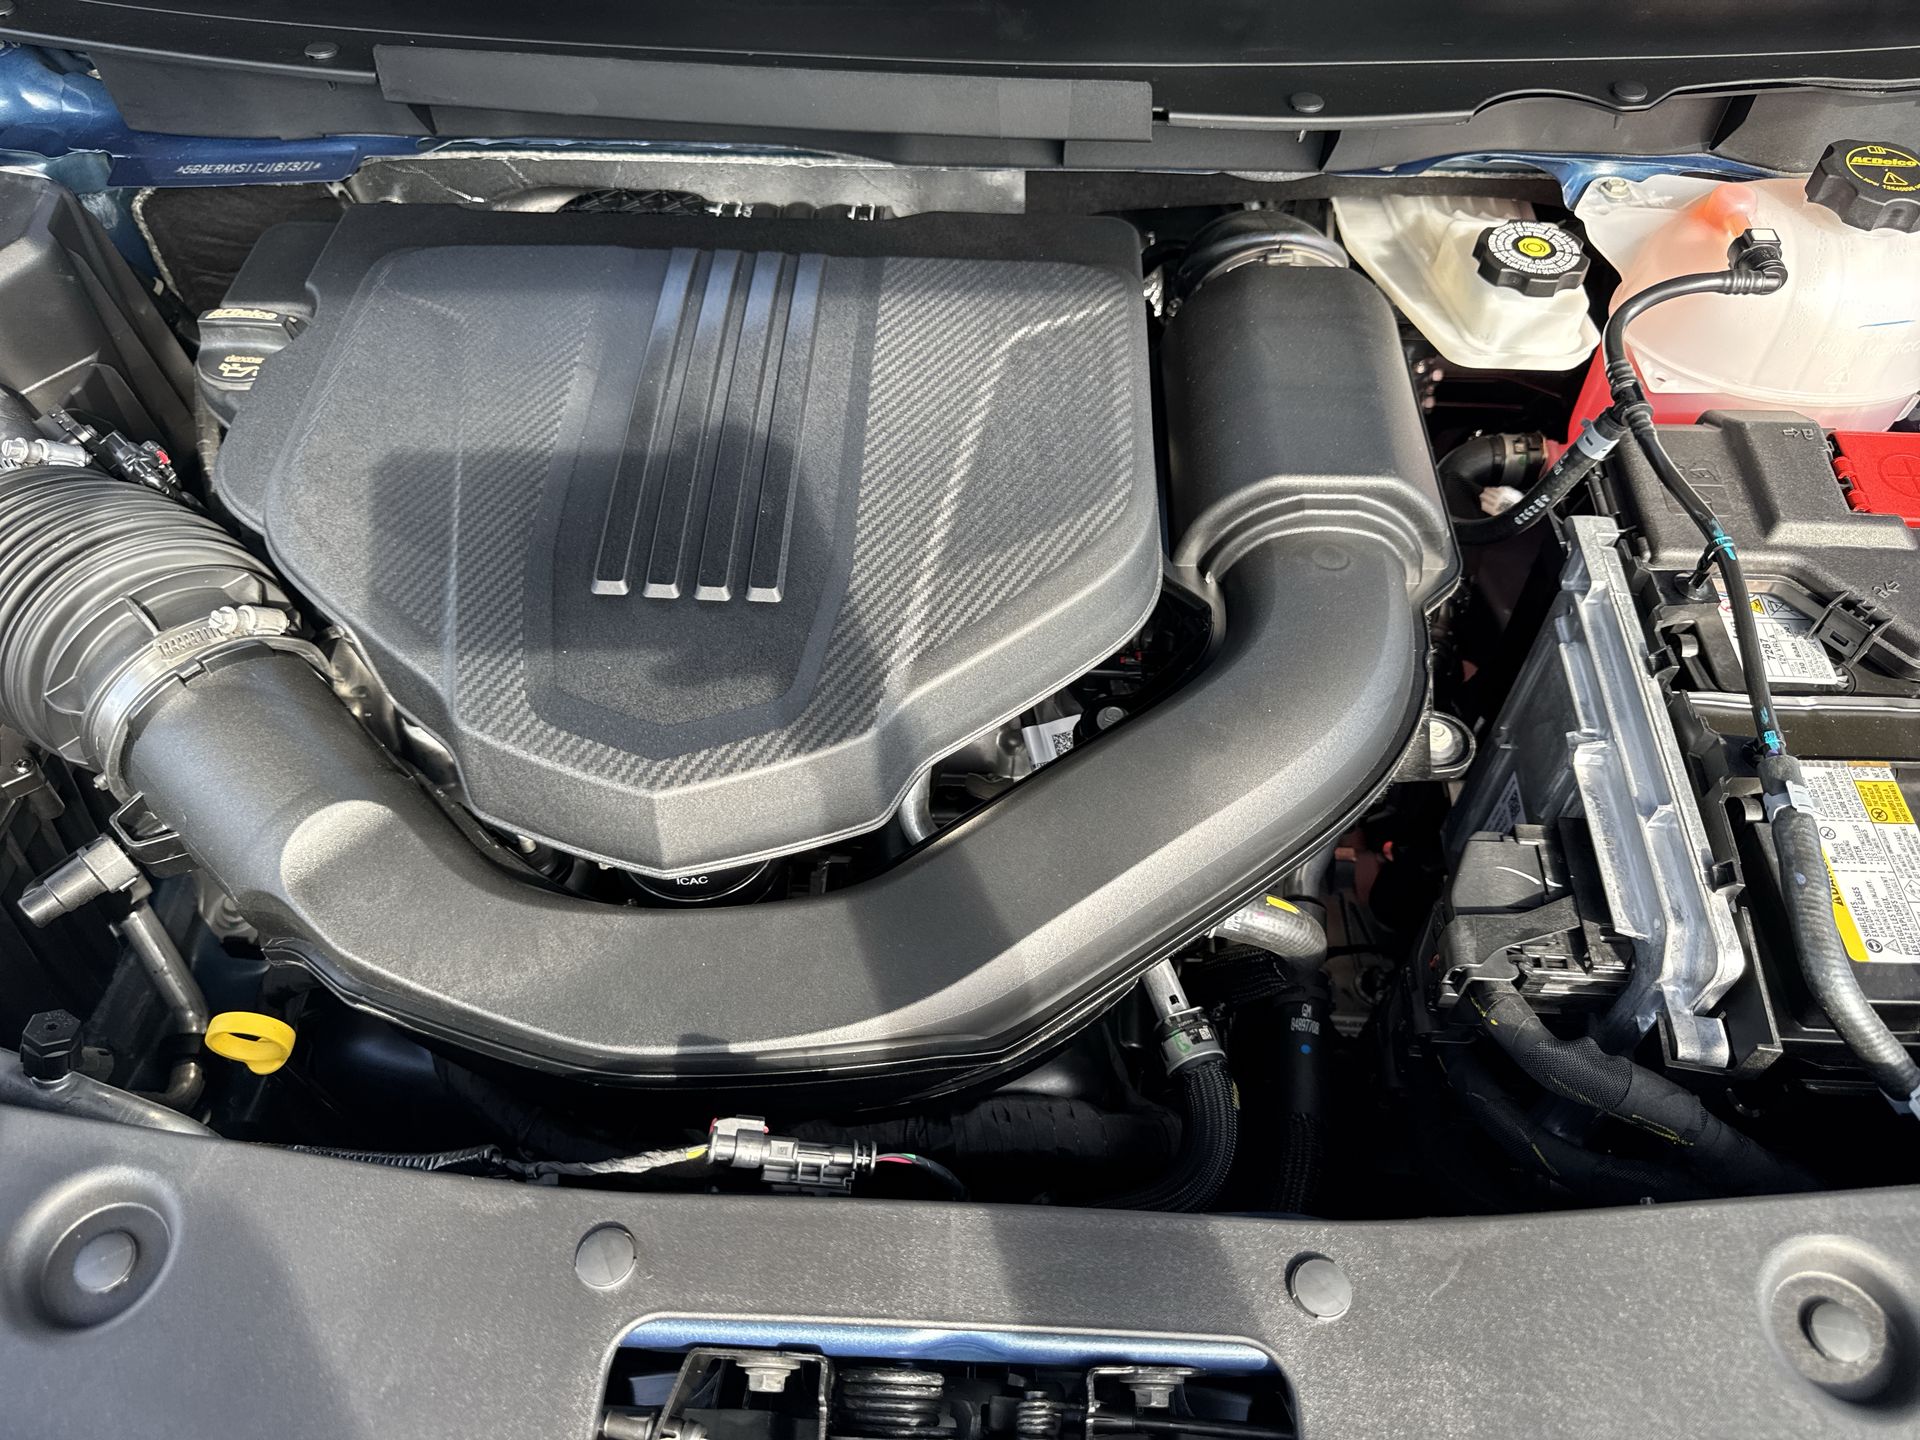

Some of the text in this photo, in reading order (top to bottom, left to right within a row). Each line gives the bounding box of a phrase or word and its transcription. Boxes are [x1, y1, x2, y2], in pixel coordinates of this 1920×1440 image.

[1850, 156, 1917, 167] ACDelco
[676, 876, 709, 885] ICAC
[1852, 887, 1879, 937] EXPLOSIVE GASES
[1891, 900, 1909, 930] EXPLOSIFS
[1888, 914, 1899, 924] LES
[1857, 918, 1871, 937] SHIELD
[1878, 927, 1887, 937] CAN
